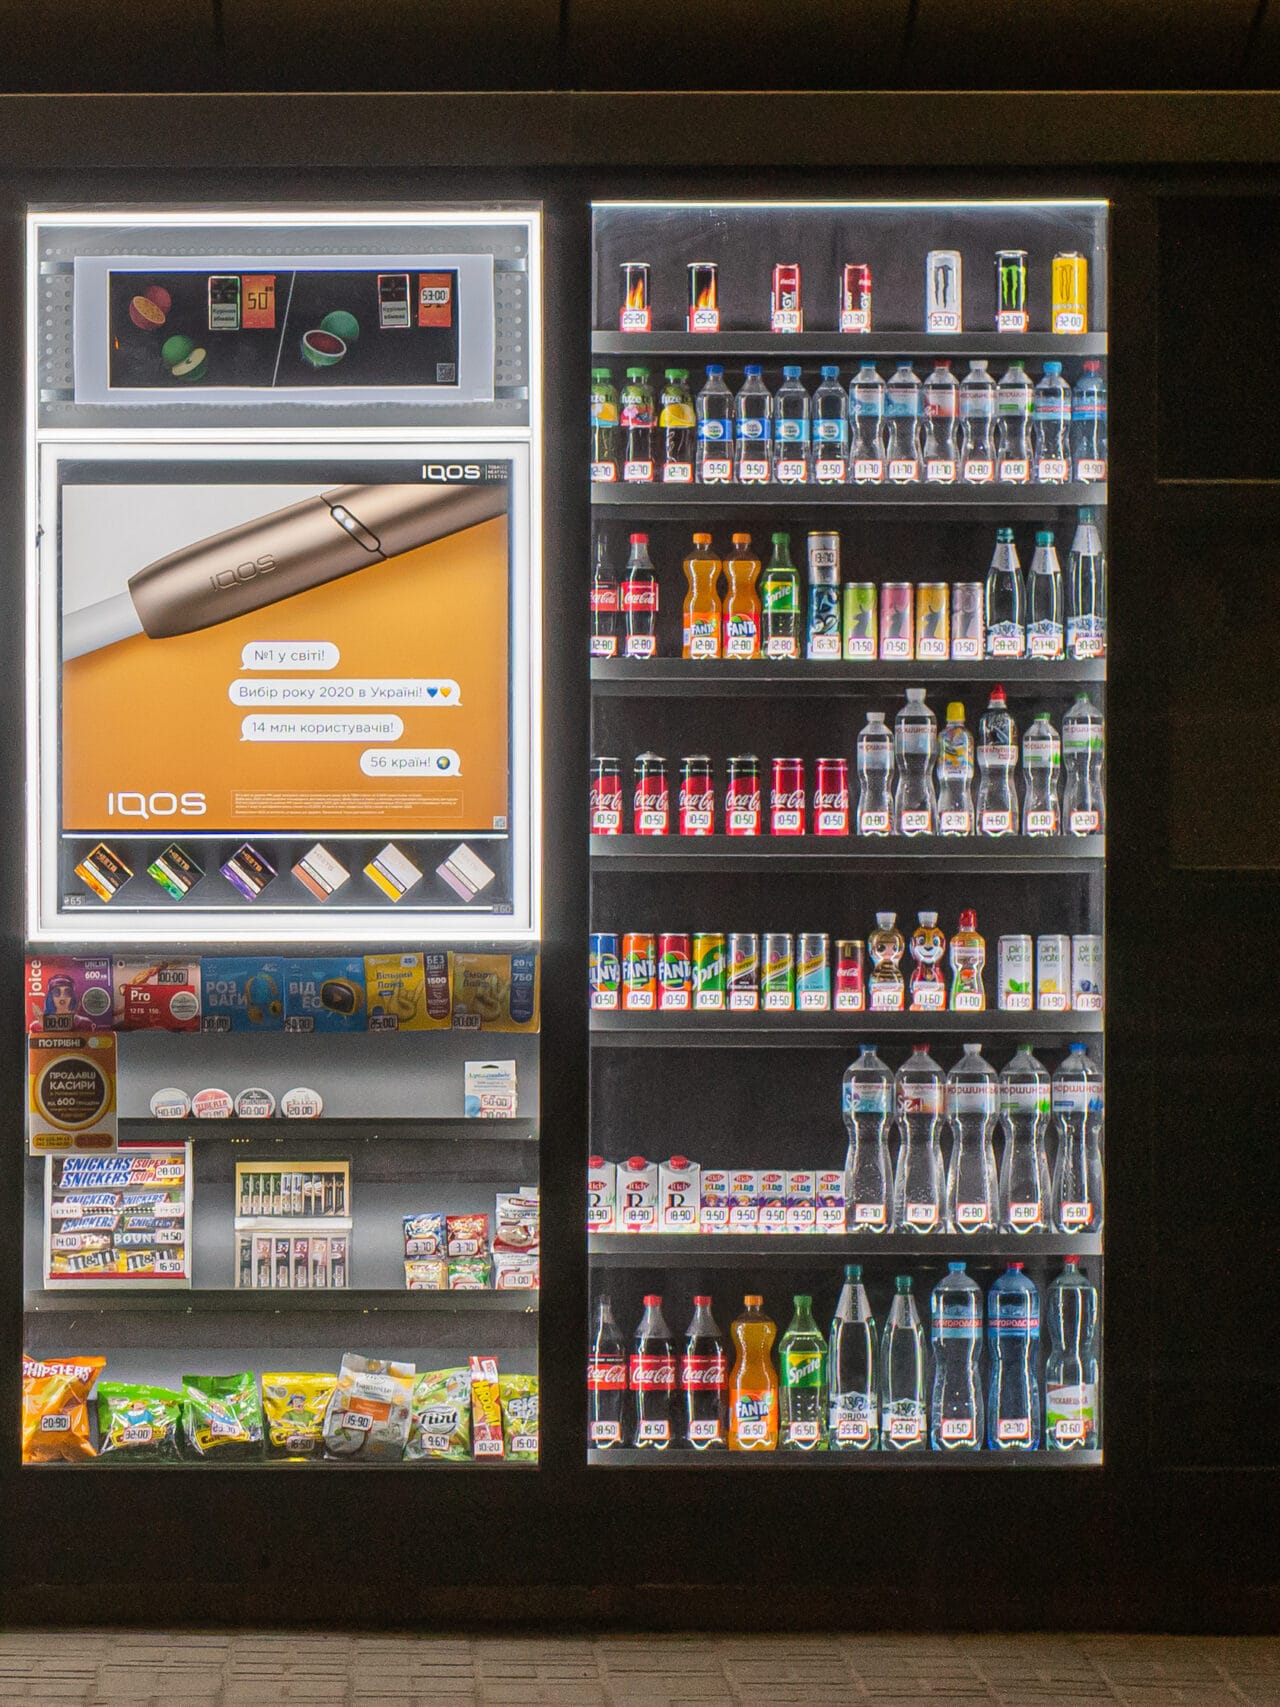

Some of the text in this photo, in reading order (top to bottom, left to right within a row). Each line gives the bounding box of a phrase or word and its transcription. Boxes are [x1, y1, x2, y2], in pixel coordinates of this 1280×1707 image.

[247, 292, 269, 311] 50
[422, 464, 480, 482] IQOS
[210, 554, 277, 592] IQOS
[254, 649, 325, 664] №1 у світі!
[238, 685, 423, 701] Вибір року 2020 в Україні!
[252, 721, 393, 736] 14 млн користувачів!
[370, 756, 431, 770] 56 країн!
[108, 791, 207, 820] IQOS
[513, 959, 525, 967] 20
[28, 959, 45, 997] joice
[85, 971, 101, 979] 600
[206, 981, 237, 993] РОЗ
[289, 982, 316, 995] ВІД
[130, 990, 151, 1001] Pro
[38, 1039, 80, 1048] ПОТРІБНІ
[49, 1072, 96, 1080] ПРОДАВЦІ
[50, 1081, 96, 1090] КАСИРИ
[57, 1098, 75, 1106] 600
[63, 1158, 131, 1171] SNICKERS
[62, 1172, 130, 1187] SNICKERS
[706, 1174, 721, 1182] Rich
[764, 1174, 780, 1182] Rich
[629, 1182, 647, 1190] Rich
[65, 1193, 116, 1205] SNICKERS
[63, 1216, 115, 1230] SNICKERS
[22, 1361, 93, 1381] CHIPSTERS
[632, 1366, 675, 1384] Coca-Cola
[682, 1366, 726, 1384] Coca-Cola
[787, 1358, 821, 1383] Sprite
